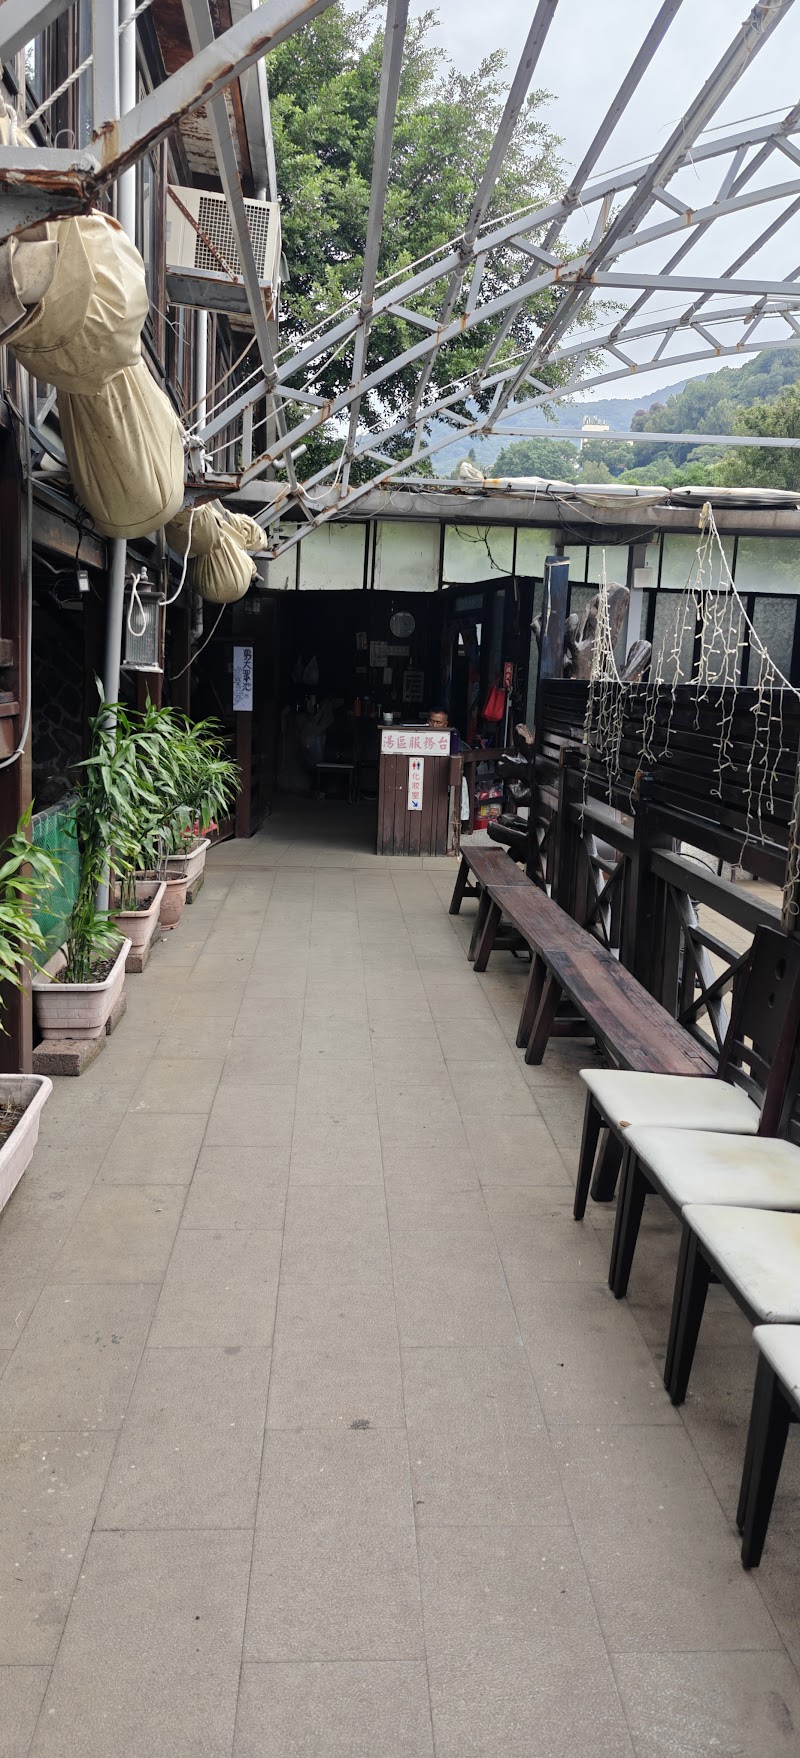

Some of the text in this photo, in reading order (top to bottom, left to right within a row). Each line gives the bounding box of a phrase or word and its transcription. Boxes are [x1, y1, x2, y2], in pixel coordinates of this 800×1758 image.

[383, 735, 448, 751] 湯區服務台
